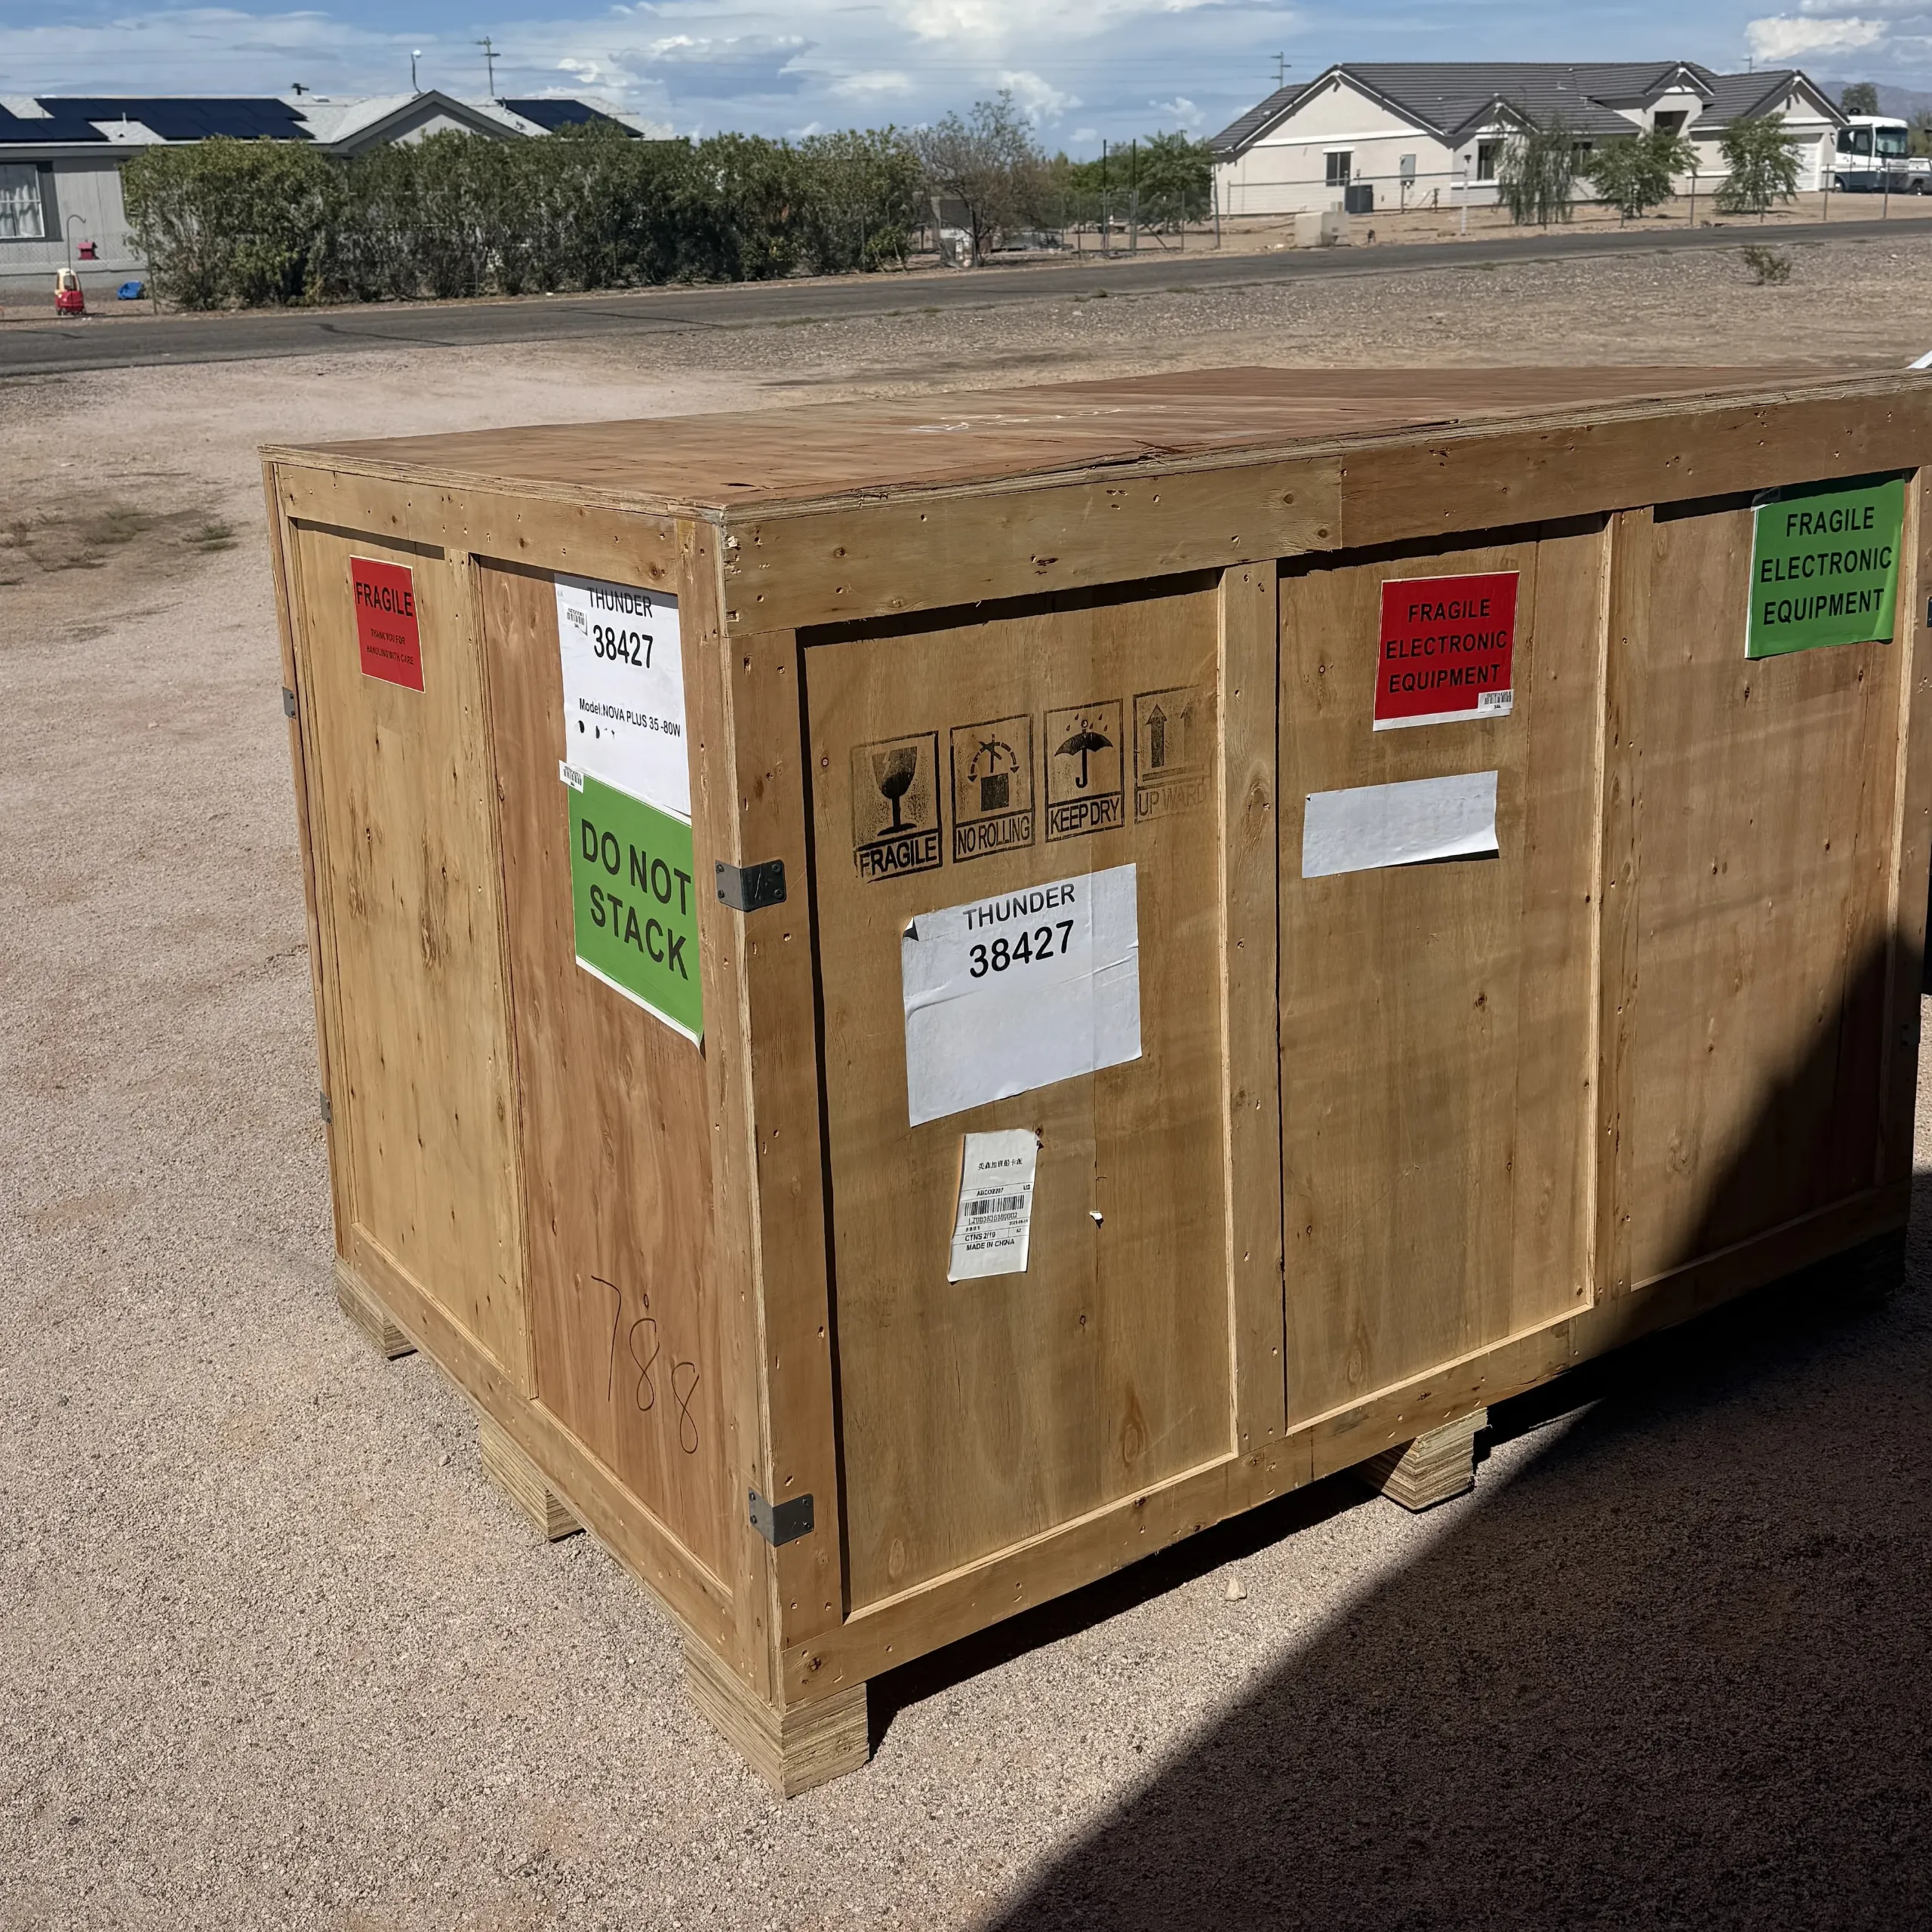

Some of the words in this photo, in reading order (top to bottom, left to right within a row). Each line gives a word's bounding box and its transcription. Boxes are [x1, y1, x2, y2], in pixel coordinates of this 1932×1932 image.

[1786, 506, 1875, 537] FRAGILE
[1761, 546, 1892, 583] ELECTRONIC
[355, 581, 414, 617] FRAGILE
[587, 586, 653, 618] THUNDER
[1408, 598, 1491, 623] FRAGILE
[1764, 589, 1884, 625] EQUIPMENT
[593, 624, 654, 669] 38427
[1386, 631, 1507, 660] ELECTRONIC
[1389, 664, 1500, 694] EQUIPMENT
[626, 710, 648, 728] PLUS
[649, 716, 659, 731] 35
[1051, 803, 1088, 835] KEEP
[1090, 797, 1120, 826] DRY
[1138, 790, 1159, 817] UP
[958, 826, 976, 855] NO
[978, 815, 1030, 850] ROLLING
[582, 818, 620, 875] DO
[630, 844, 691, 915] NOT
[859, 835, 937, 878] FRAGILE
[963, 883, 1075, 931] THUNDER
[590, 884, 688, 981] STACK
[970, 919, 1074, 978] 38427
[965, 1233, 983, 1241] CTNS
[966, 1242, 985, 1251] MADE
[995, 1238, 1014, 1248] CHINA
[591, 1275, 699, 1454] 788
